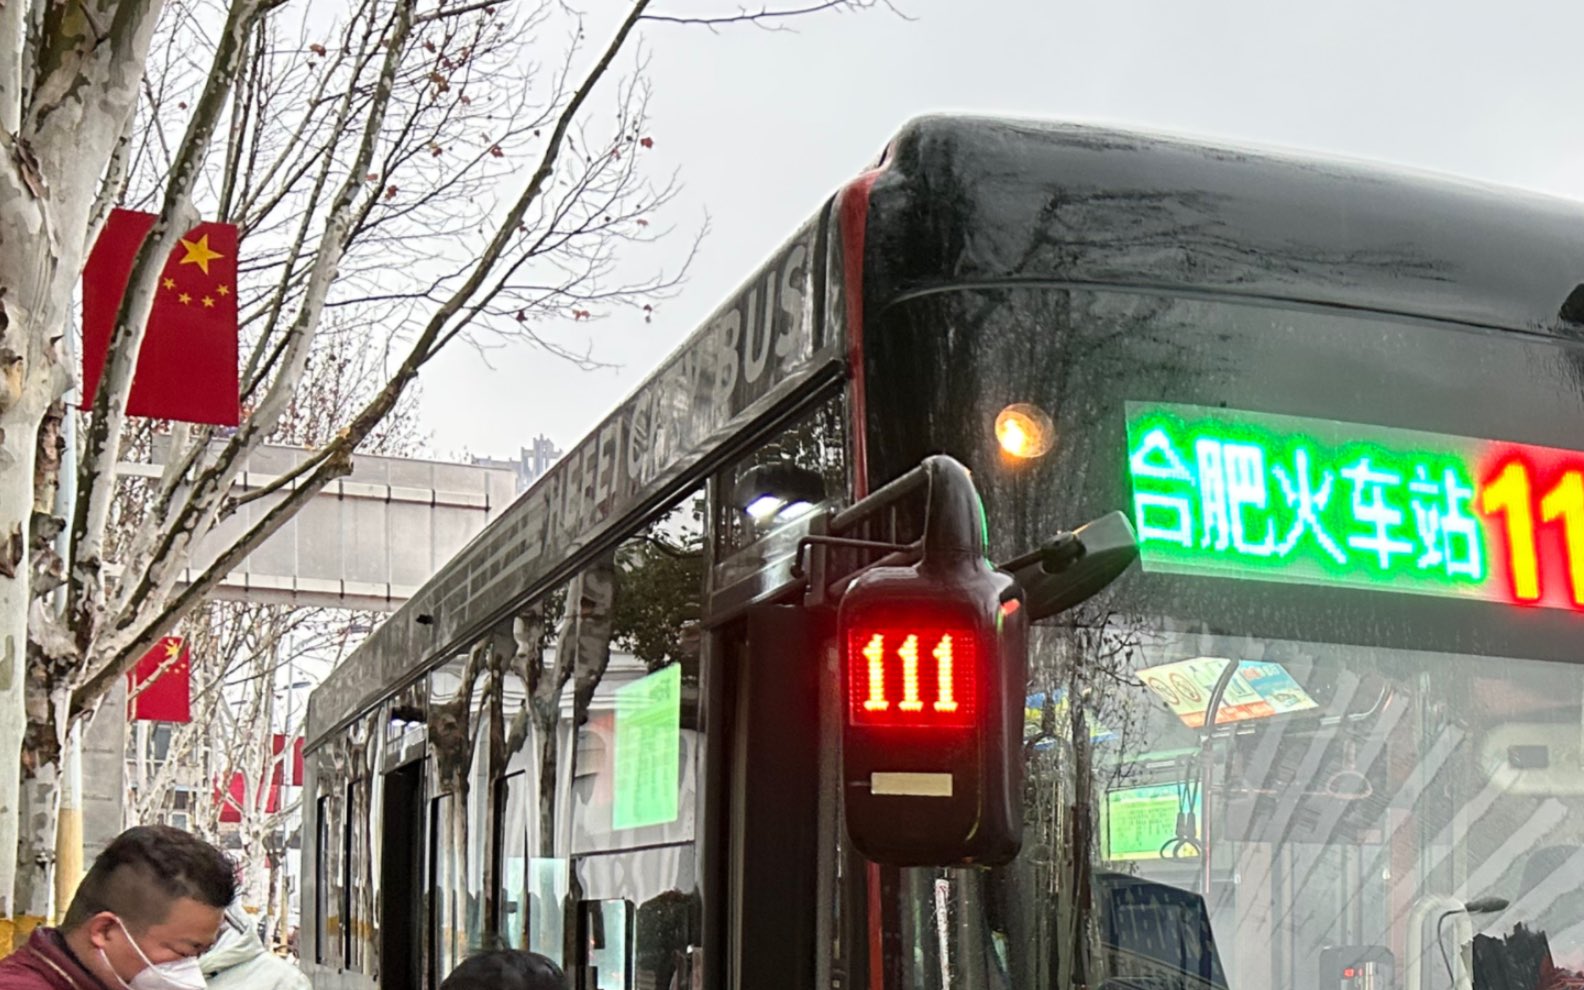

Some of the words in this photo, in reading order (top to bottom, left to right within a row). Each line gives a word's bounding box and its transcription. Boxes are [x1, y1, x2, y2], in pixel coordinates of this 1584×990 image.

[711, 244, 807, 404] BUS
[1129, 427, 1483, 579] 合肥火车站
[862, 633, 958, 712] 111
